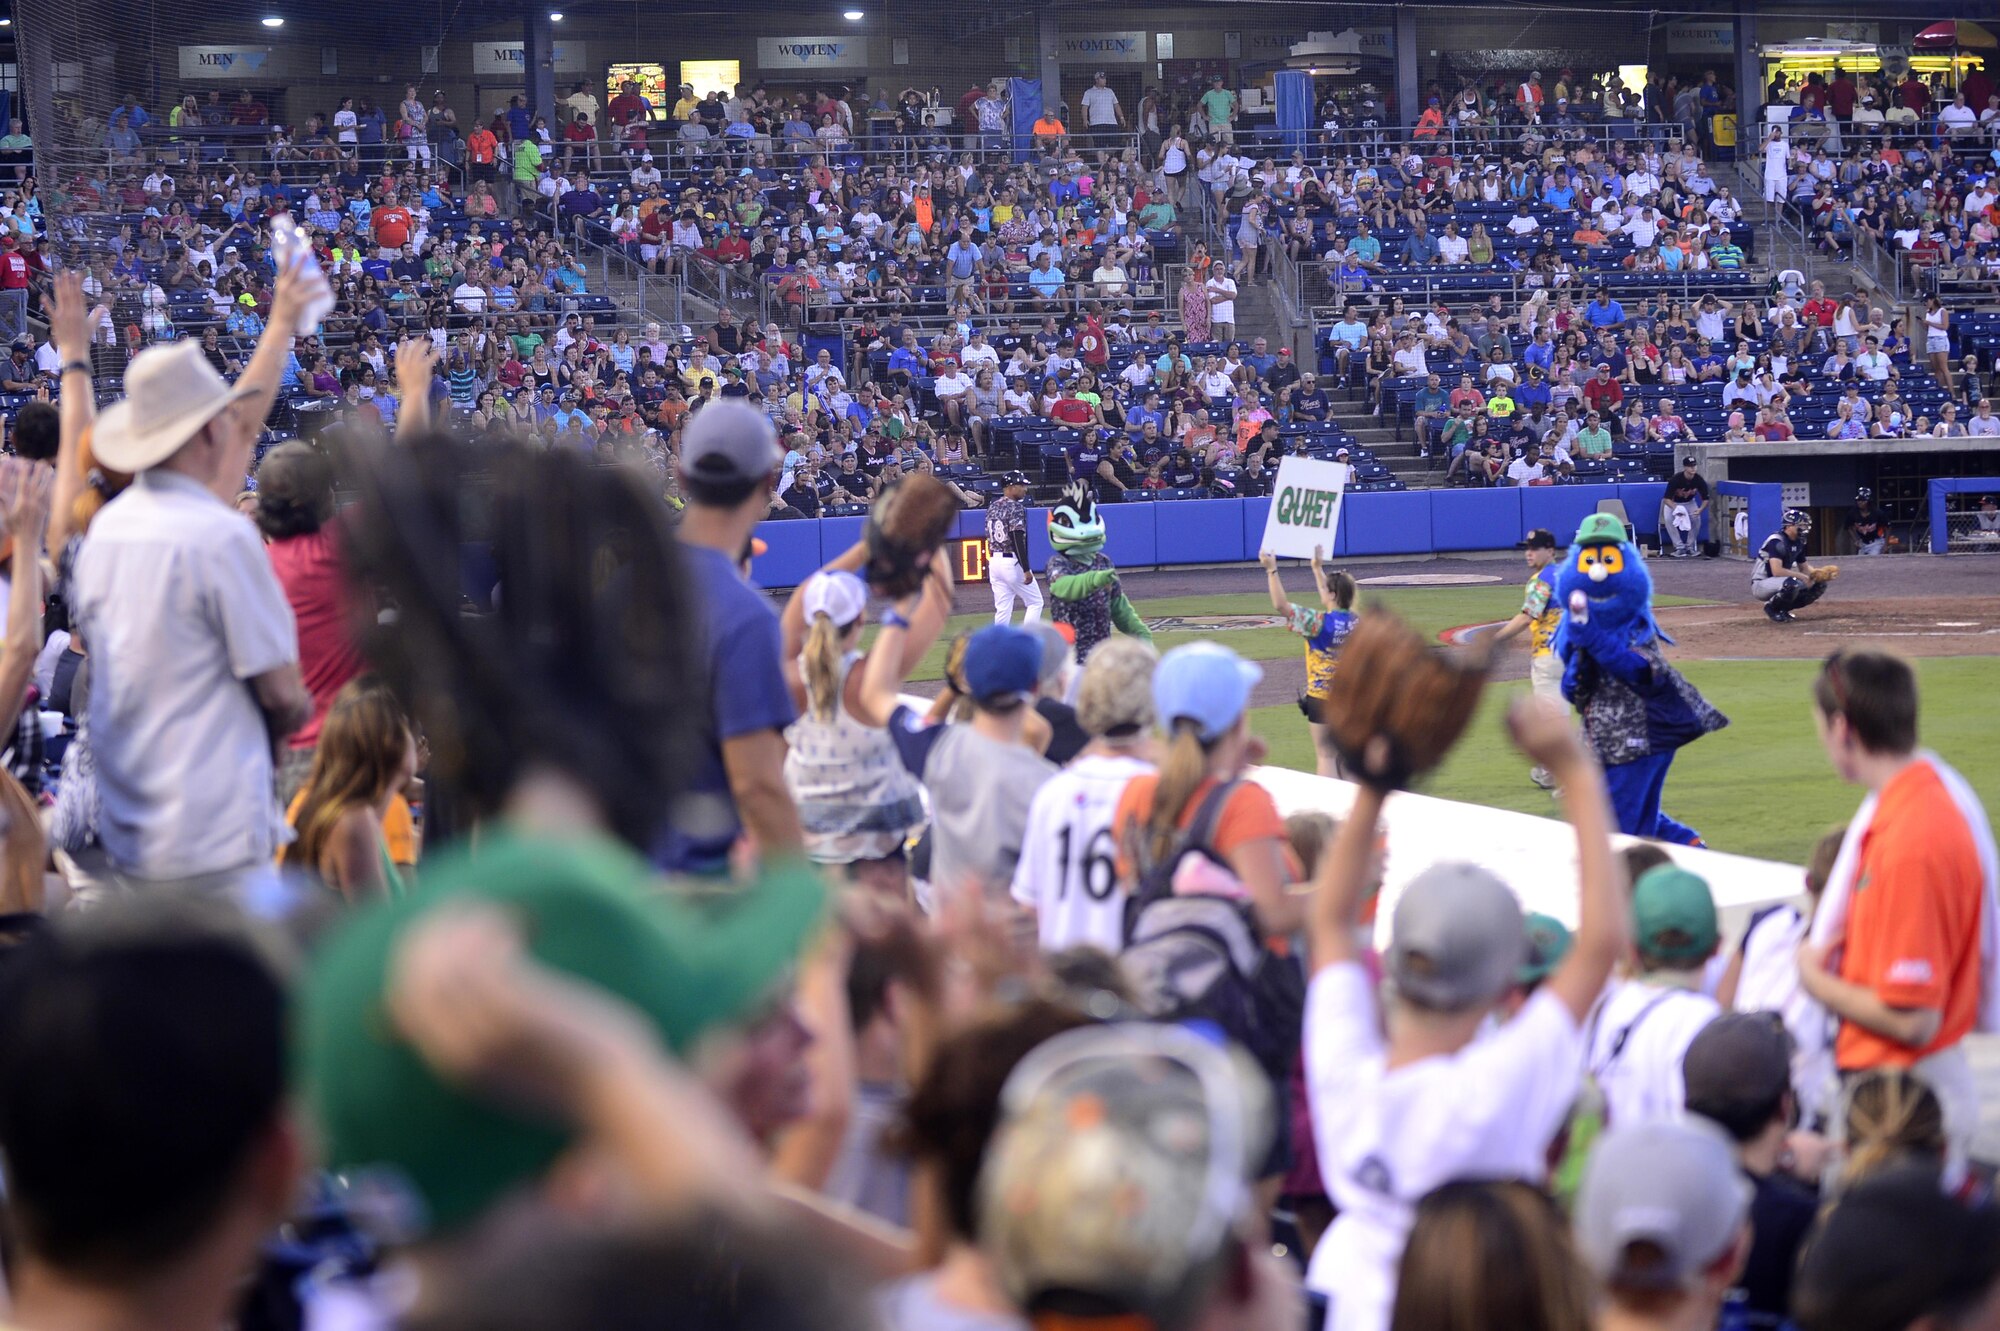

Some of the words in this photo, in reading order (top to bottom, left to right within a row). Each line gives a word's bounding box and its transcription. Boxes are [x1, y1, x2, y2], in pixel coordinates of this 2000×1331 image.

[1671, 29, 1719, 39] SECURITY
[778, 44, 838, 56] WOMEN
[1065, 39, 1126, 51] WOMEN
[199, 53, 233, 65] MEN
[1277, 486, 1338, 529] QUIET
[987, 519, 1005, 543] 18
[1058, 823, 1117, 901] 16
